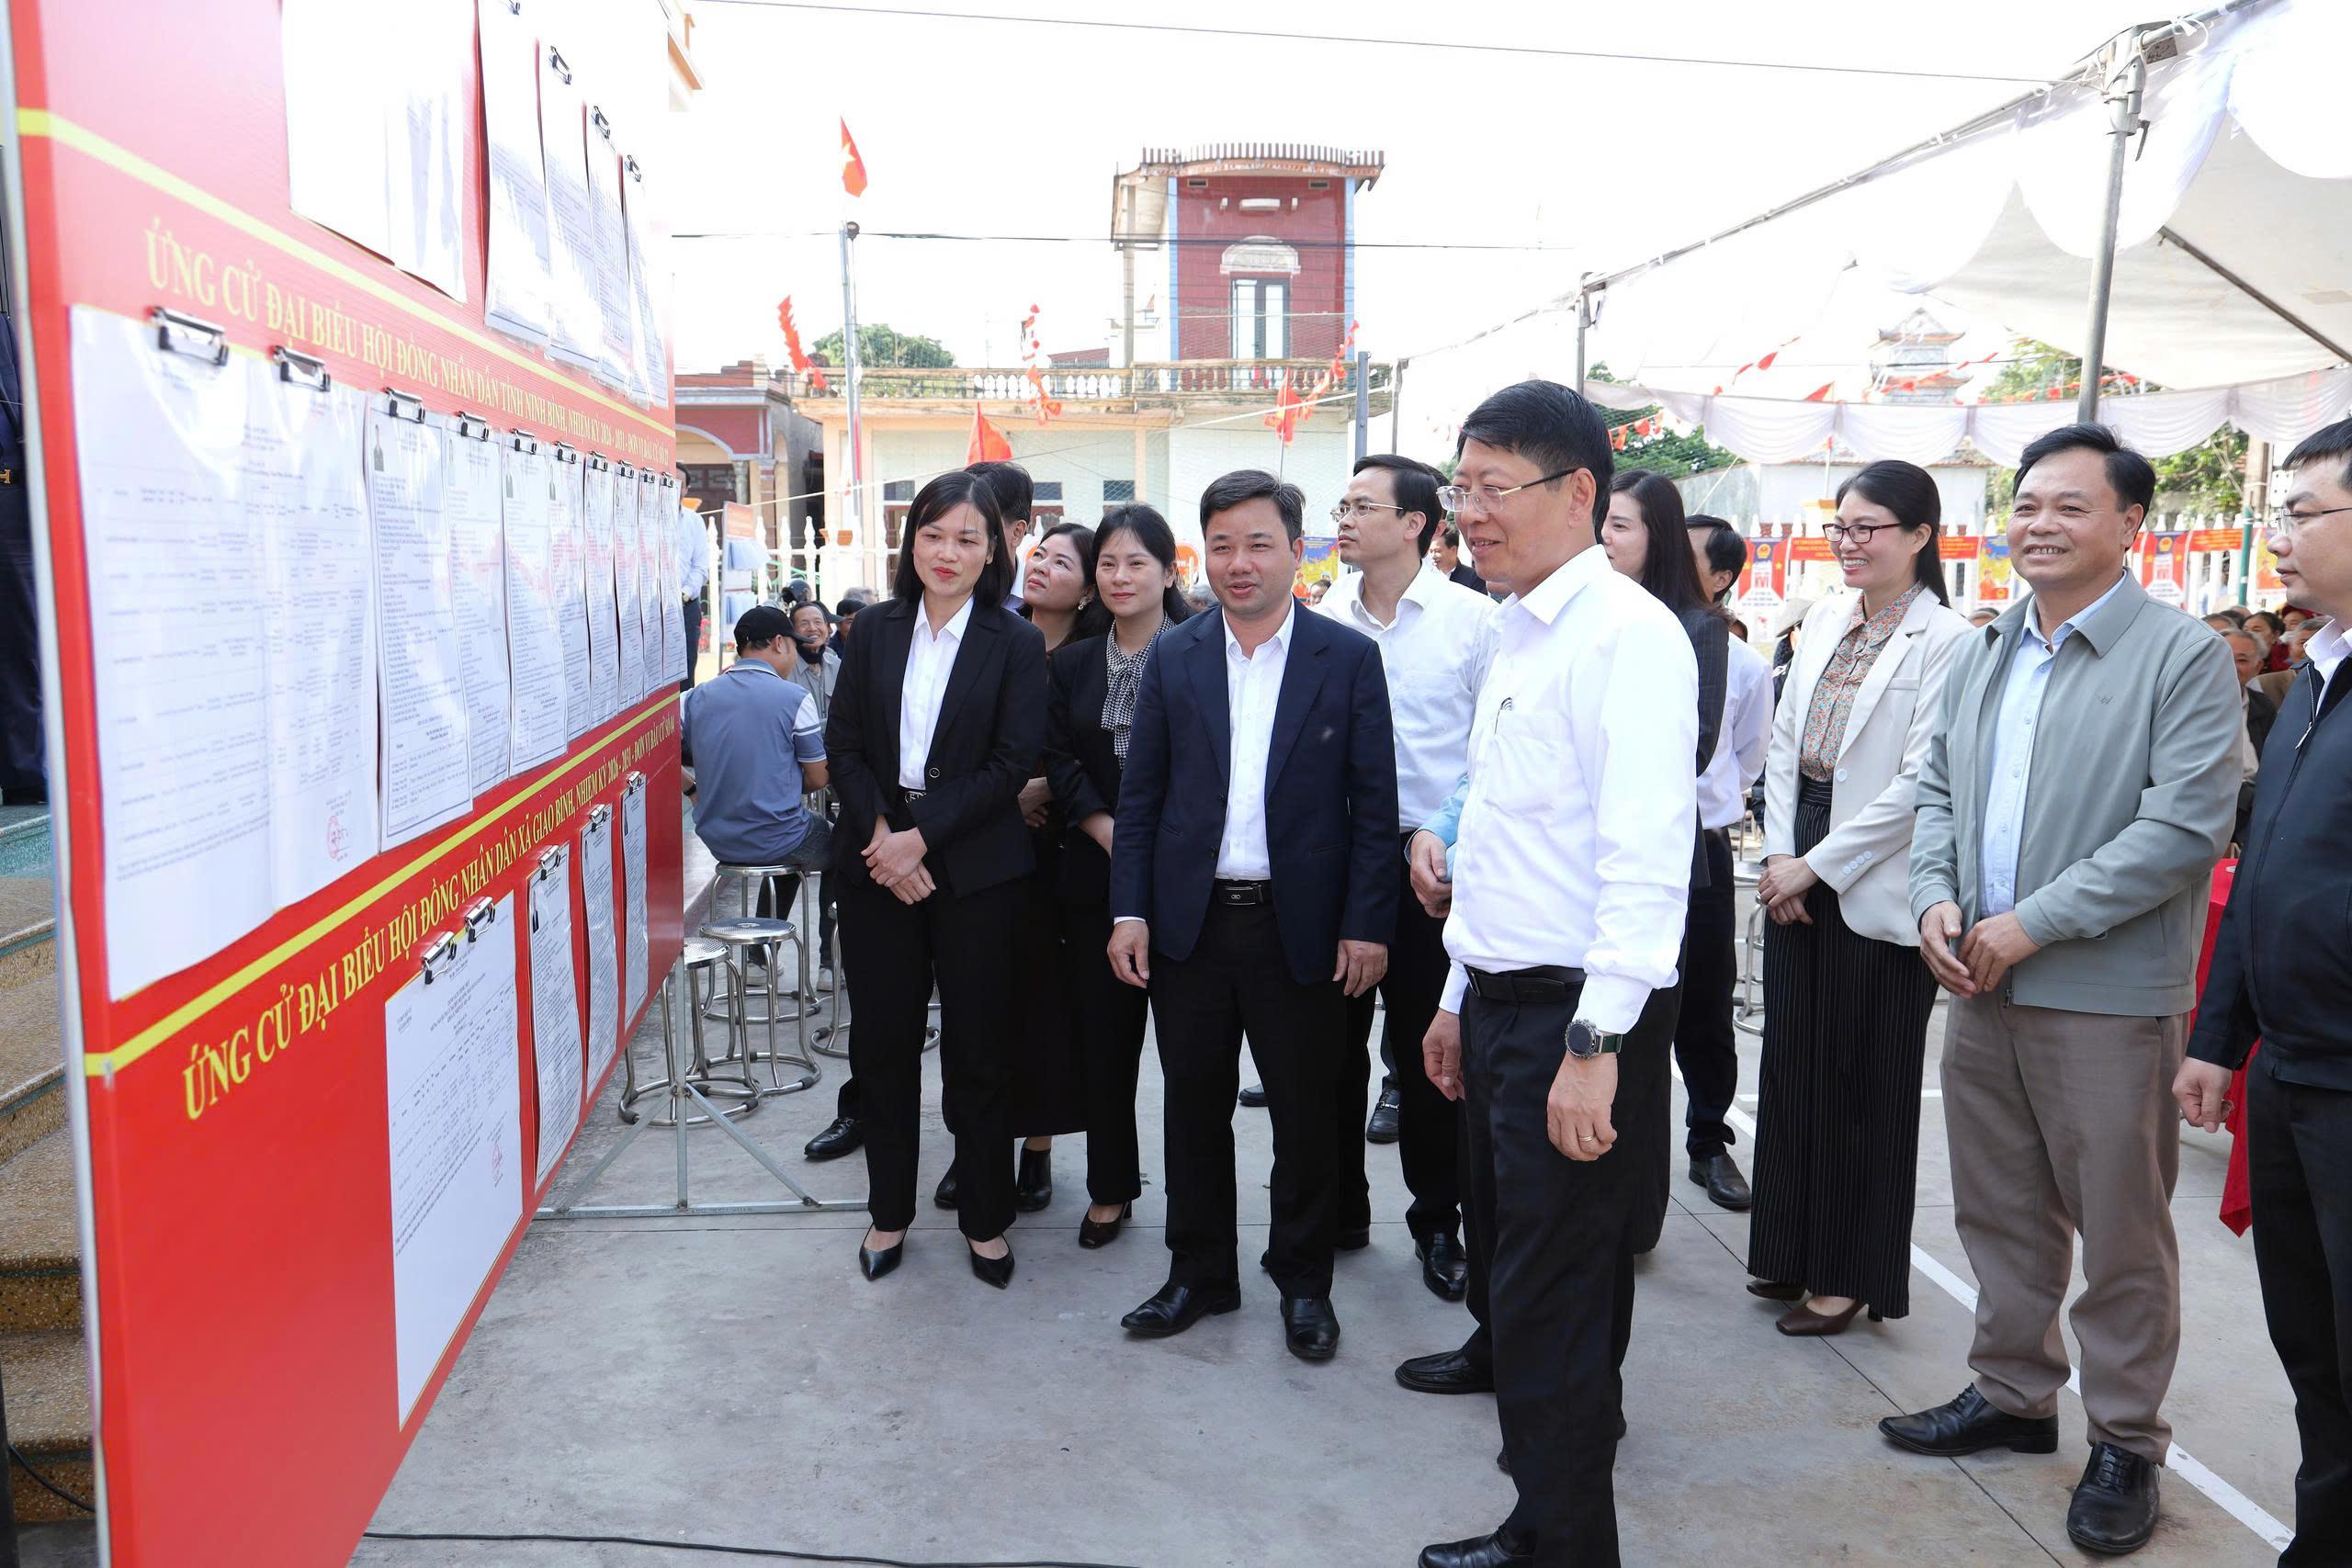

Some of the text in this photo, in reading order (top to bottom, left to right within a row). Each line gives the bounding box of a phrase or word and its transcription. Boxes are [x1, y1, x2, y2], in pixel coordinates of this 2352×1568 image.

[146, 216, 216, 306] ỨNG
[222, 258, 261, 321] CỬ
[266, 282, 307, 347] ĐẠI
[311, 301, 357, 358] BIỂU
[362, 323, 393, 378] HỘI
[396, 333, 438, 387] ĐỒNG
[441, 355, 475, 401] NHÂN
[477, 366, 499, 409] DÂN
[501, 375, 524, 417] TỈNH
[526, 392, 546, 424] NINH
[569, 408, 591, 445] NHIỆM
[182, 1024, 252, 1121] ỨNG
[256, 984, 295, 1063] CỬ
[298, 963, 340, 1032] ĐẠI
[342, 926, 385, 1000] BIỂU
[388, 904, 417, 963] HỘI
[420, 878, 459, 936] ĐỒNG
[461, 844, 494, 903] NHÂN
[495, 827, 517, 875] DÂN
[517, 813, 532, 857] XÃ
[533, 804, 554, 844] GIAO
[555, 788, 576, 828] BÌNH,
[575, 772, 598, 810] NHIỆM
[598, 757, 606, 792] KỲ
[608, 755, 619, 784] 2026
[622, 746, 631, 773] 2031
[634, 736, 645, 762] ĐƠN
